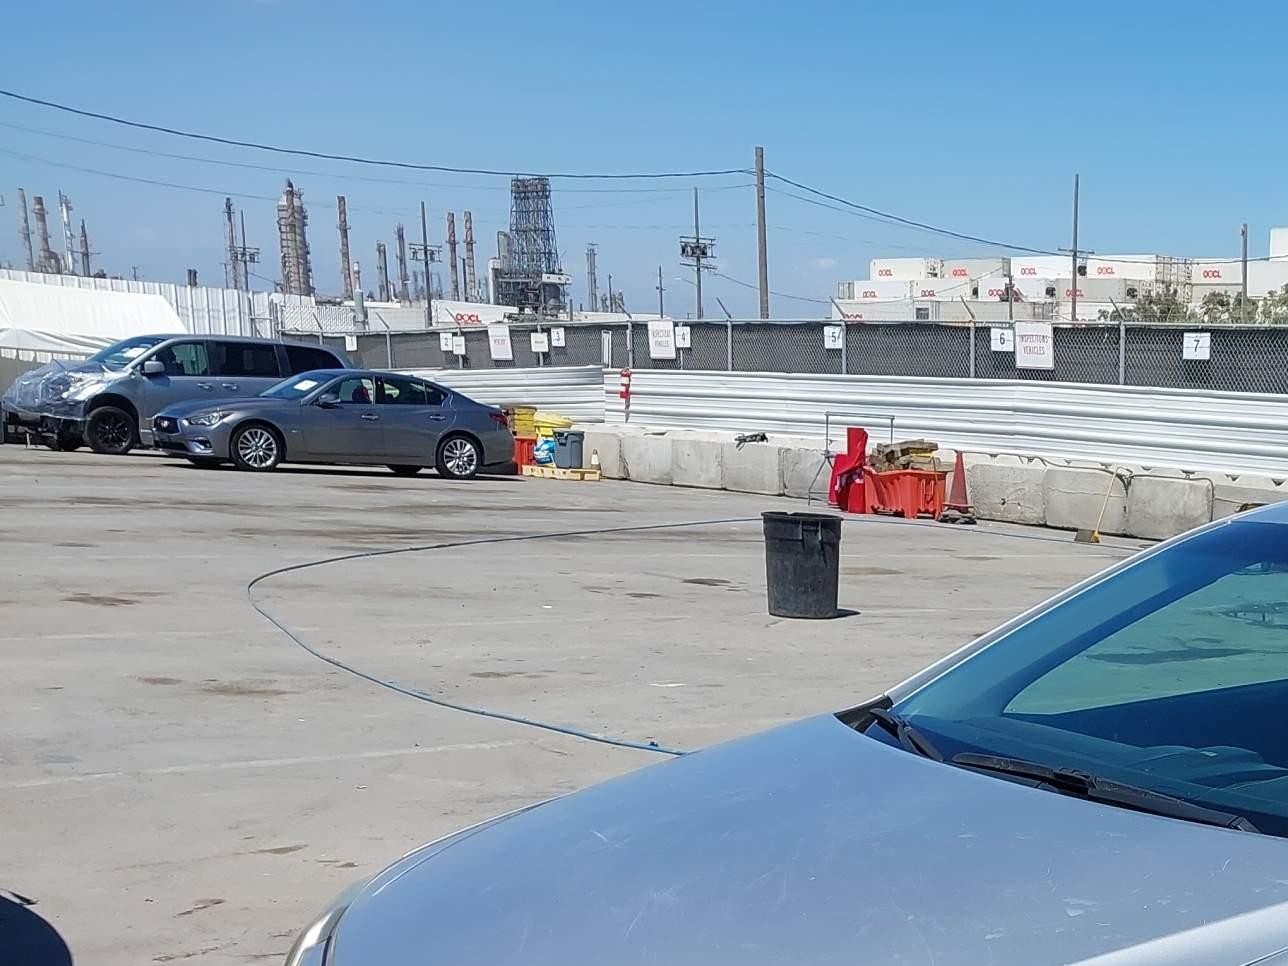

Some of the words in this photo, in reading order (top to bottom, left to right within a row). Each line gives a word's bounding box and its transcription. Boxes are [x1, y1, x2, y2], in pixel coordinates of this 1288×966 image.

[1203, 270, 1222, 279] OOCL
[455, 313, 482, 323] OOCL
[831, 332, 837, 343] 5
[999, 333, 1006, 345] 6
[1193, 339, 1200, 352] 7
